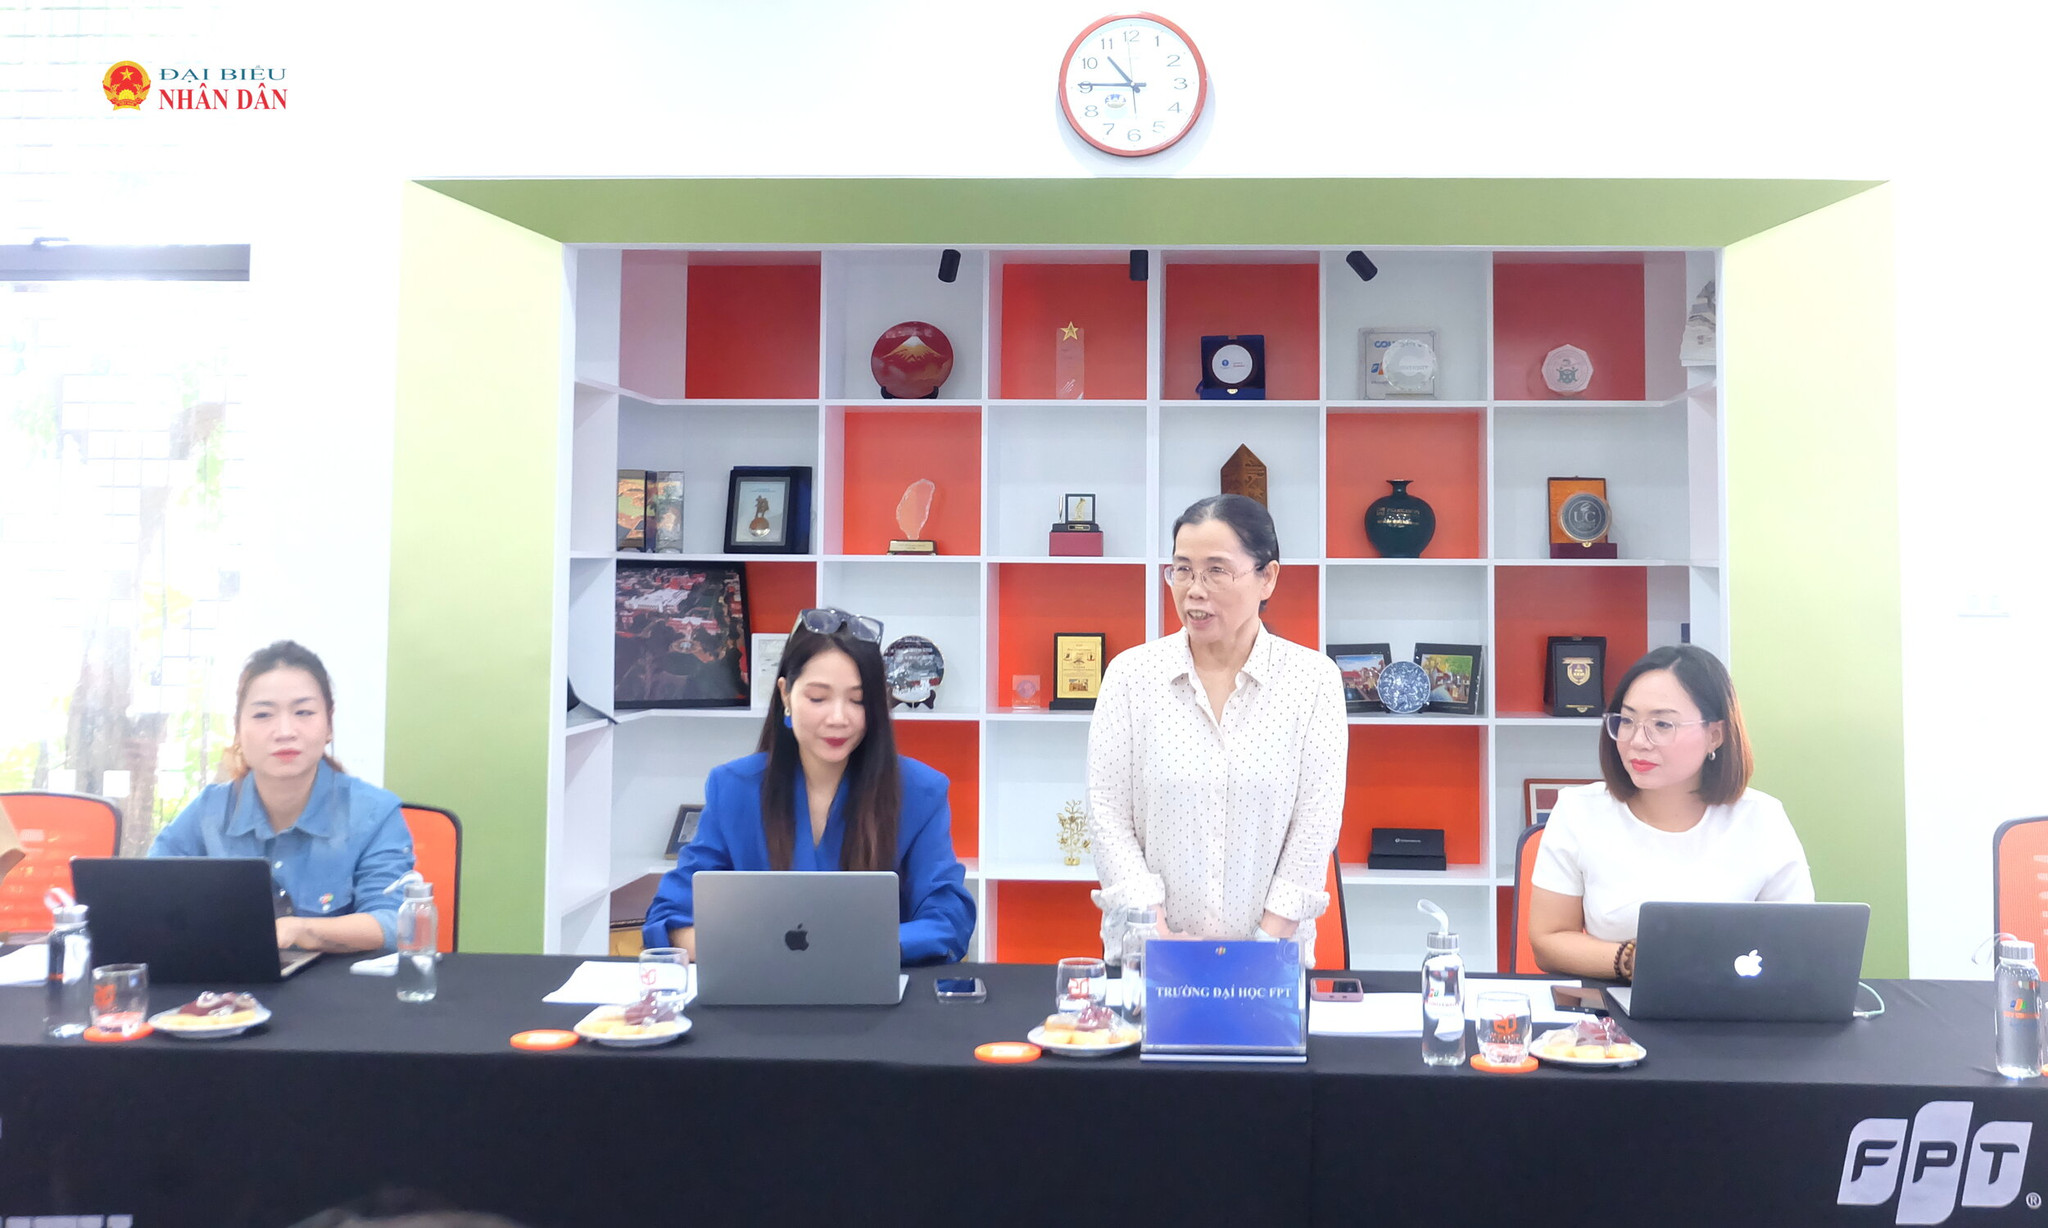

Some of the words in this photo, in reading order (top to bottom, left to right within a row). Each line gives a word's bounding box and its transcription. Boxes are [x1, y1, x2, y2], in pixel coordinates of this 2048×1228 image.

[1123, 30, 1140, 42] 12
[1154, 35, 1160, 47] 1
[1100, 38, 1113, 50] 11
[1082, 57, 1098, 70] 10
[1166, 54, 1181, 67] 2
[1078, 81, 1093, 94] 9
[1173, 77, 1188, 90] 3
[1084, 105, 1099, 118] 8
[1167, 101, 1182, 113] 4
[1102, 123, 1115, 136] 7
[1152, 120, 1166, 133] 5
[1127, 129, 1142, 142] 6
[1155, 983, 1210, 999] TRƯỜNG
[1238, 986, 1266, 1001] HỌC
[1269, 986, 1292, 999] FPT
